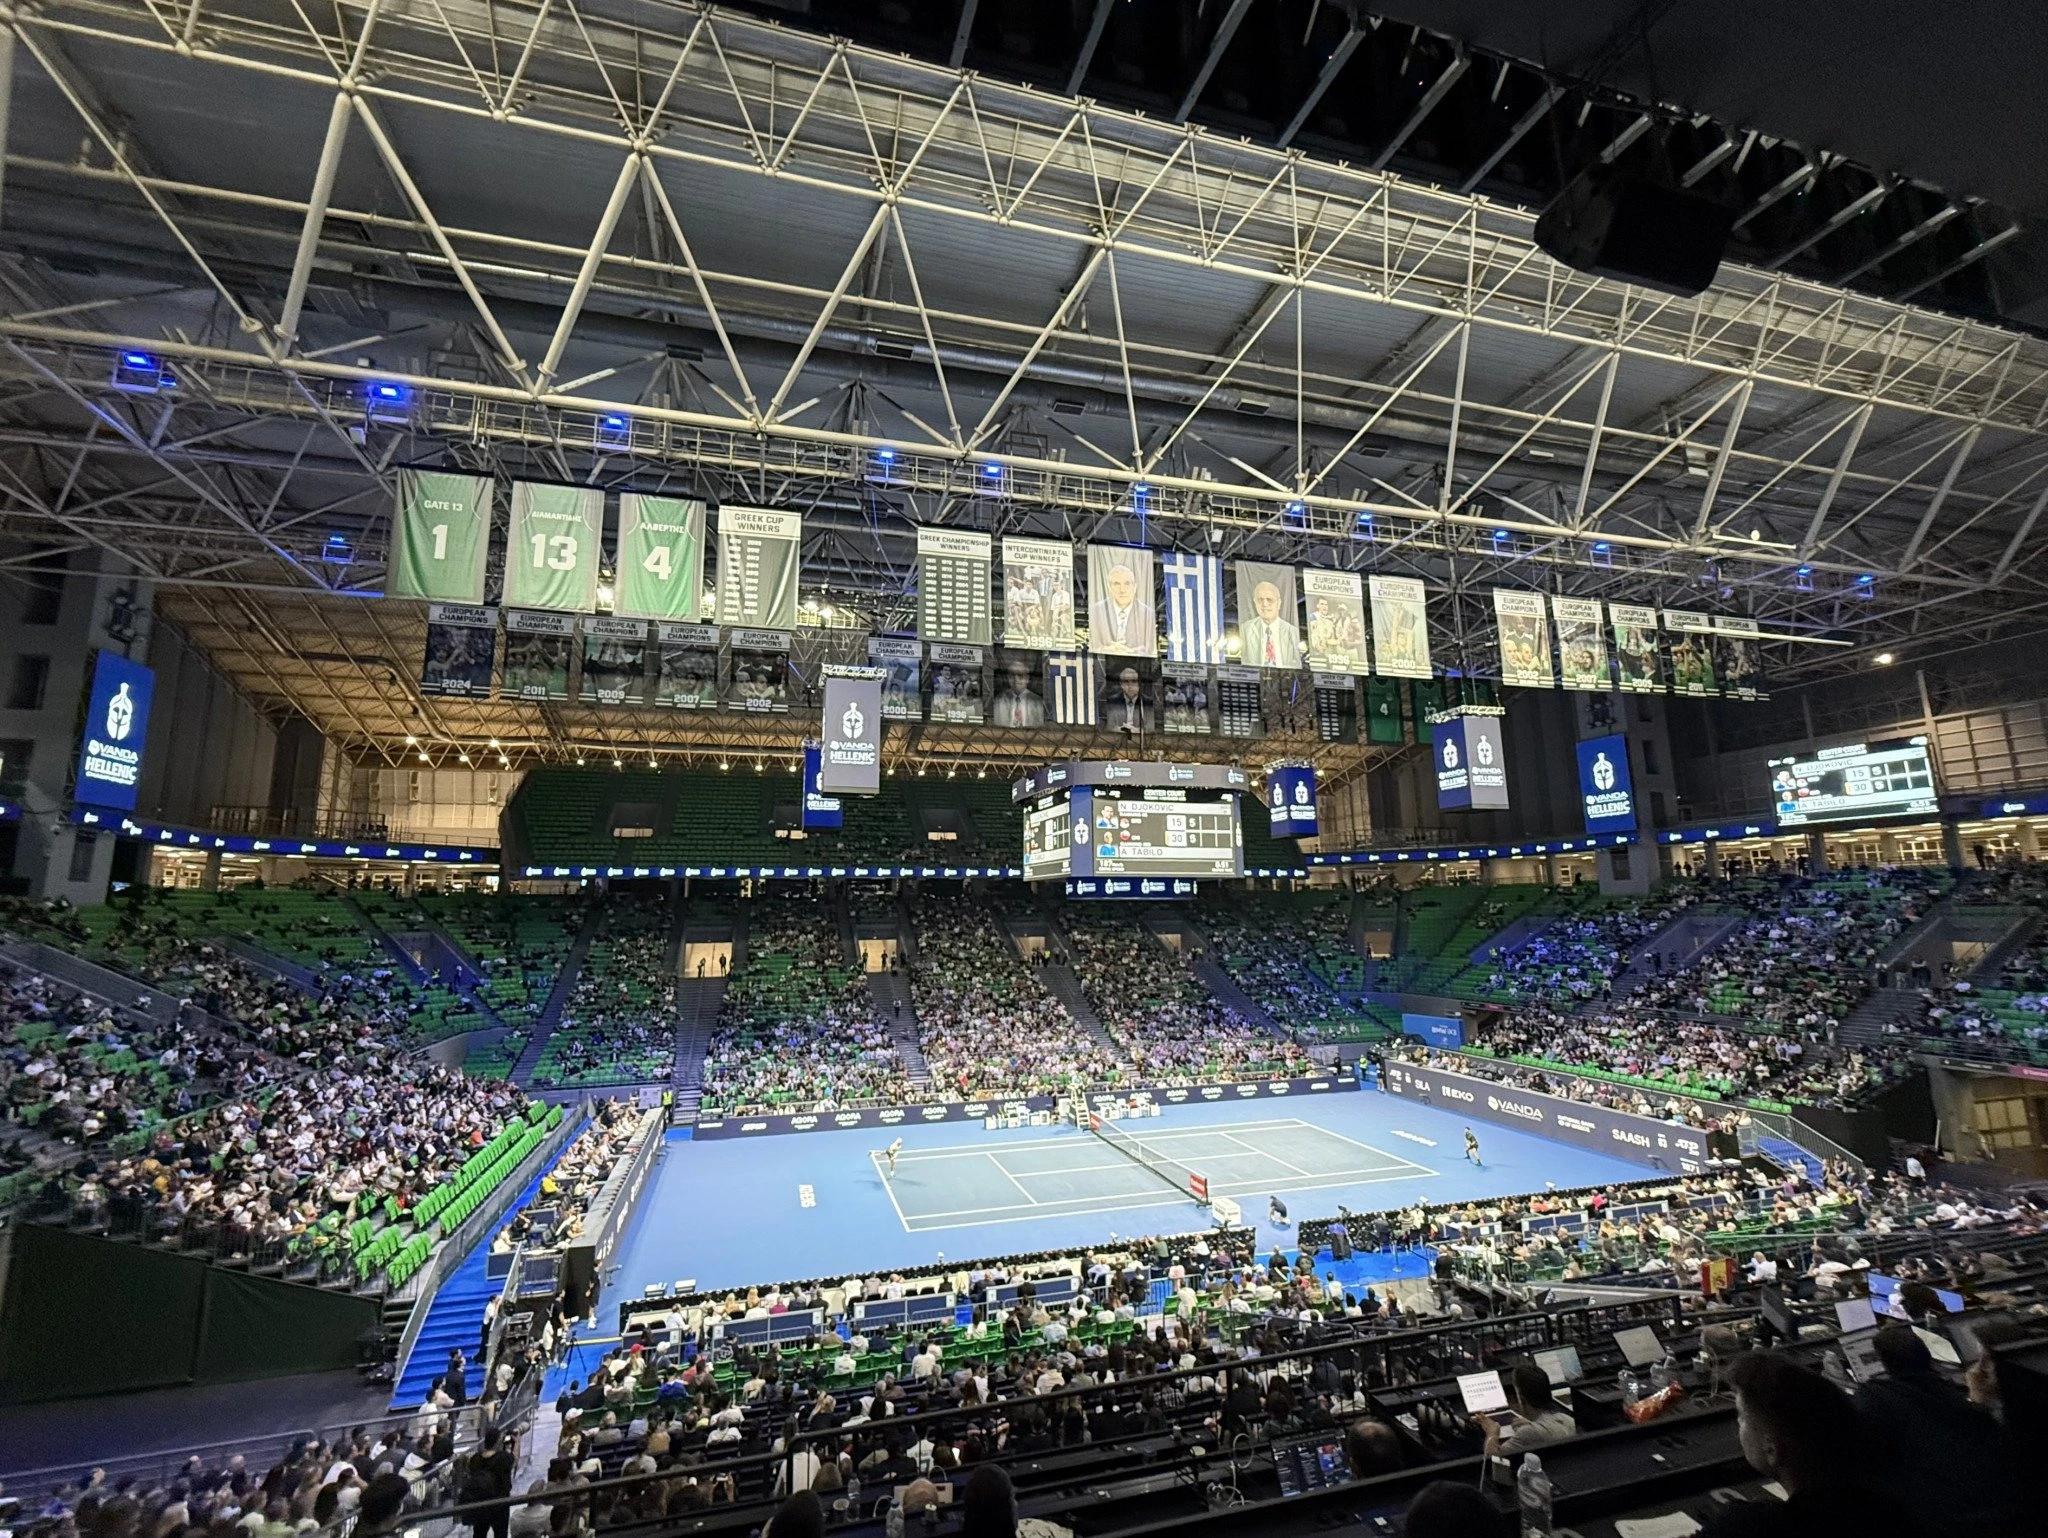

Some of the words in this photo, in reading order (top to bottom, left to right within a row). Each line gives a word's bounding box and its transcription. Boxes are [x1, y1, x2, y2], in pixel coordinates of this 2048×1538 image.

[424, 500, 449, 511] GATE
[452, 502, 463, 512] 13
[734, 513, 763, 524] GREEK
[765, 516, 784, 525] CUP
[640, 522, 686, 534] ΑΛΒΕΡΤΗΣ
[738, 523, 780, 533] WINNERS
[432, 524, 448, 560] 1
[920, 534, 941, 543] GREEK
[942, 536, 990, 548] CHAMPIONSHIP
[531, 533, 578, 571] 13
[940, 543, 970, 552] WINNERS
[1005, 545, 1069, 557] INTERCONTINENTAL
[1014, 553, 1028, 561] CUP
[1029, 554, 1061, 563] WINNERS
[642, 546, 672, 581] 4
[1314, 575, 1351, 587] EUROPEAN
[1312, 582, 1354, 595] CHAMPIONS
[1379, 582, 1415, 593] EUROPEAN
[1377, 589, 1418, 600] CHAMPIONS
[1503, 597, 1535, 607] EUROPEAN
[1561, 602, 1593, 612] EUROPEAN
[442, 606, 486, 617] EUROPEAN
[1501, 604, 1538, 614] CHAMPIONS
[1560, 609, 1596, 619] CHAMPIONS
[1617, 608, 1648, 618] EUROPEAN
[438, 613, 488, 624] CHAMPIONS
[520, 614, 562, 625] EUROPEAN
[1616, 614, 1650, 625] CHAMPIONS
[1671, 613, 1699, 622] EUROPEAN
[516, 620, 565, 632] CHAMPIONS
[596, 619, 636, 630] EUROPEAN
[1723, 620, 1750, 629] EUROPEAN
[592, 626, 639, 636] CHAMPIONS
[670, 626, 709, 636] EUROPEAN
[667, 633, 712, 642] CHAMPIONS
[743, 632, 780, 641] EUROPEAN
[1026, 635, 1053, 648] 1996
[740, 639, 783, 648] CHAMPIONS
[878, 641, 913, 650] EUROPEAN
[875, 647, 915, 657] CHAMPIONS
[940, 647, 974, 656] EUROPEAN
[938, 653, 976, 662] CHAMPIONS
[1391, 658, 1416, 669] 2000
[1516, 670, 1539, 680] 2002
[1576, 674, 1598, 684] 2007
[441, 678, 472, 690] 2024
[1631, 677, 1653, 688] 2009
[523, 685, 546, 696] 2011
[597, 689, 625, 700] 2009
[674, 694, 700, 704] 2007
[746, 699, 772, 708] 2002
[883, 705, 907, 715] 2000
[947, 710, 967, 719] 1996
[1379, 703, 1389, 716] 4
[839, 741, 875, 750] VANDA
[99, 743, 138, 761] VANDA
[830, 751, 876, 762] HELLENIC
[85, 756, 137, 780] HELLENIC
[1807, 759, 1854, 771] DJOKOVIC
[1852, 769, 1864, 777] 15
[1854, 783, 1867, 791] 30
[1593, 791, 1629, 801] VANDA
[1131, 803, 1174, 811] DJOKOVIC
[1813, 798, 1846, 807] TABILO
[1587, 801, 1631, 815] HELLENIC
[1171, 818, 1182, 827] 15
[1188, 818, 1196, 828] 5
[1171, 834, 1182, 843] 30
[1189, 834, 1196, 844] 5
[1166, 1089, 1189, 1098] AGORA
[922, 1106, 948, 1115] AGORA
[963, 1103, 989, 1113] AGORA
[1498, 1099, 1544, 1119] VANDA
[834, 1113, 862, 1122] AGORA
[878, 1109, 905, 1118] AGORA
[791, 1116, 818, 1125] AGORA
[1612, 1129, 1650, 1148] SAASH
